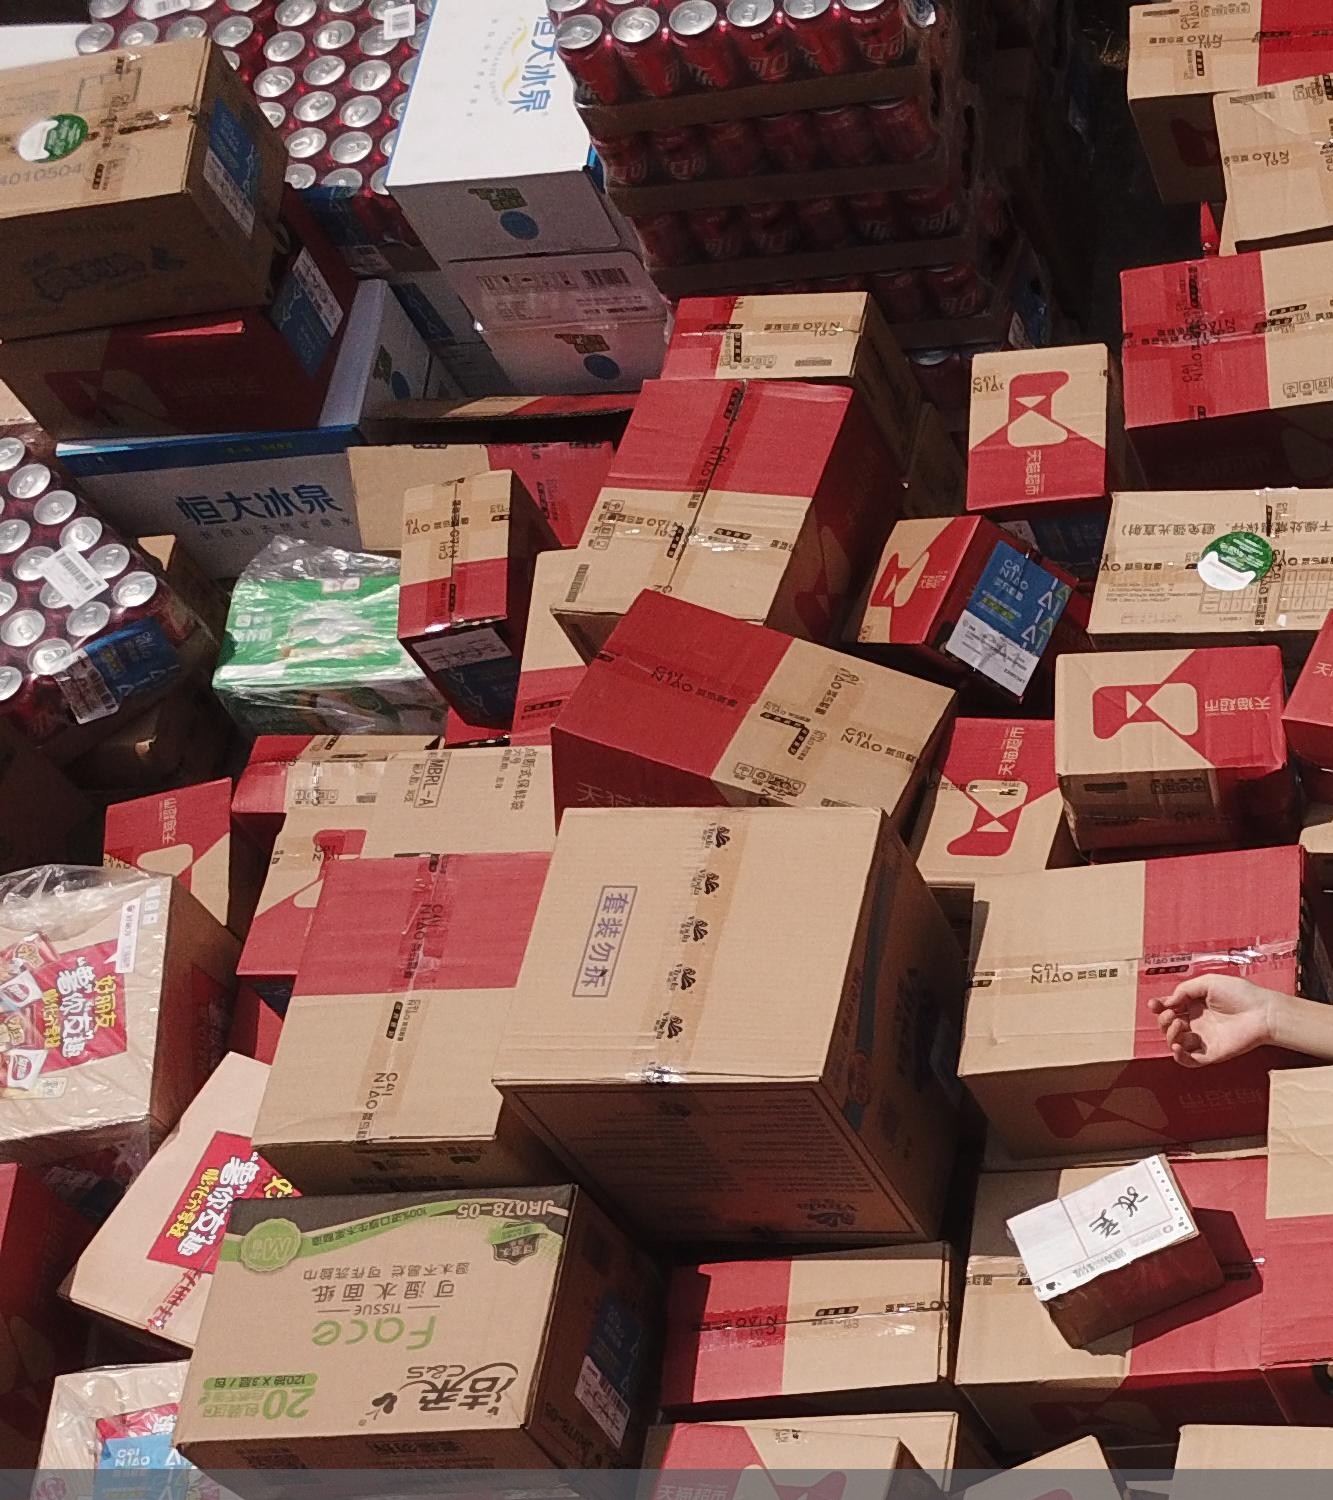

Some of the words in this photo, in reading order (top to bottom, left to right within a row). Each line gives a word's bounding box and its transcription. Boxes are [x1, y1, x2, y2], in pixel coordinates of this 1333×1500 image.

[175, 485, 343, 527] 恒大冰泉
[1204, 696, 1271, 715] 天猫超市
[580, 891, 631, 990] 套装勿拆
[456, 1199, 557, 1219] JR078-05
[312, 1280, 456, 1304] 可湿水面纸
[354, 1304, 402, 1316] TISSUE
[312, 1315, 437, 1351] Face
[406, 1364, 467, 1380] C&S
[262, 1387, 316, 1420] 20
[419, 1373, 518, 1417] 洁柔
